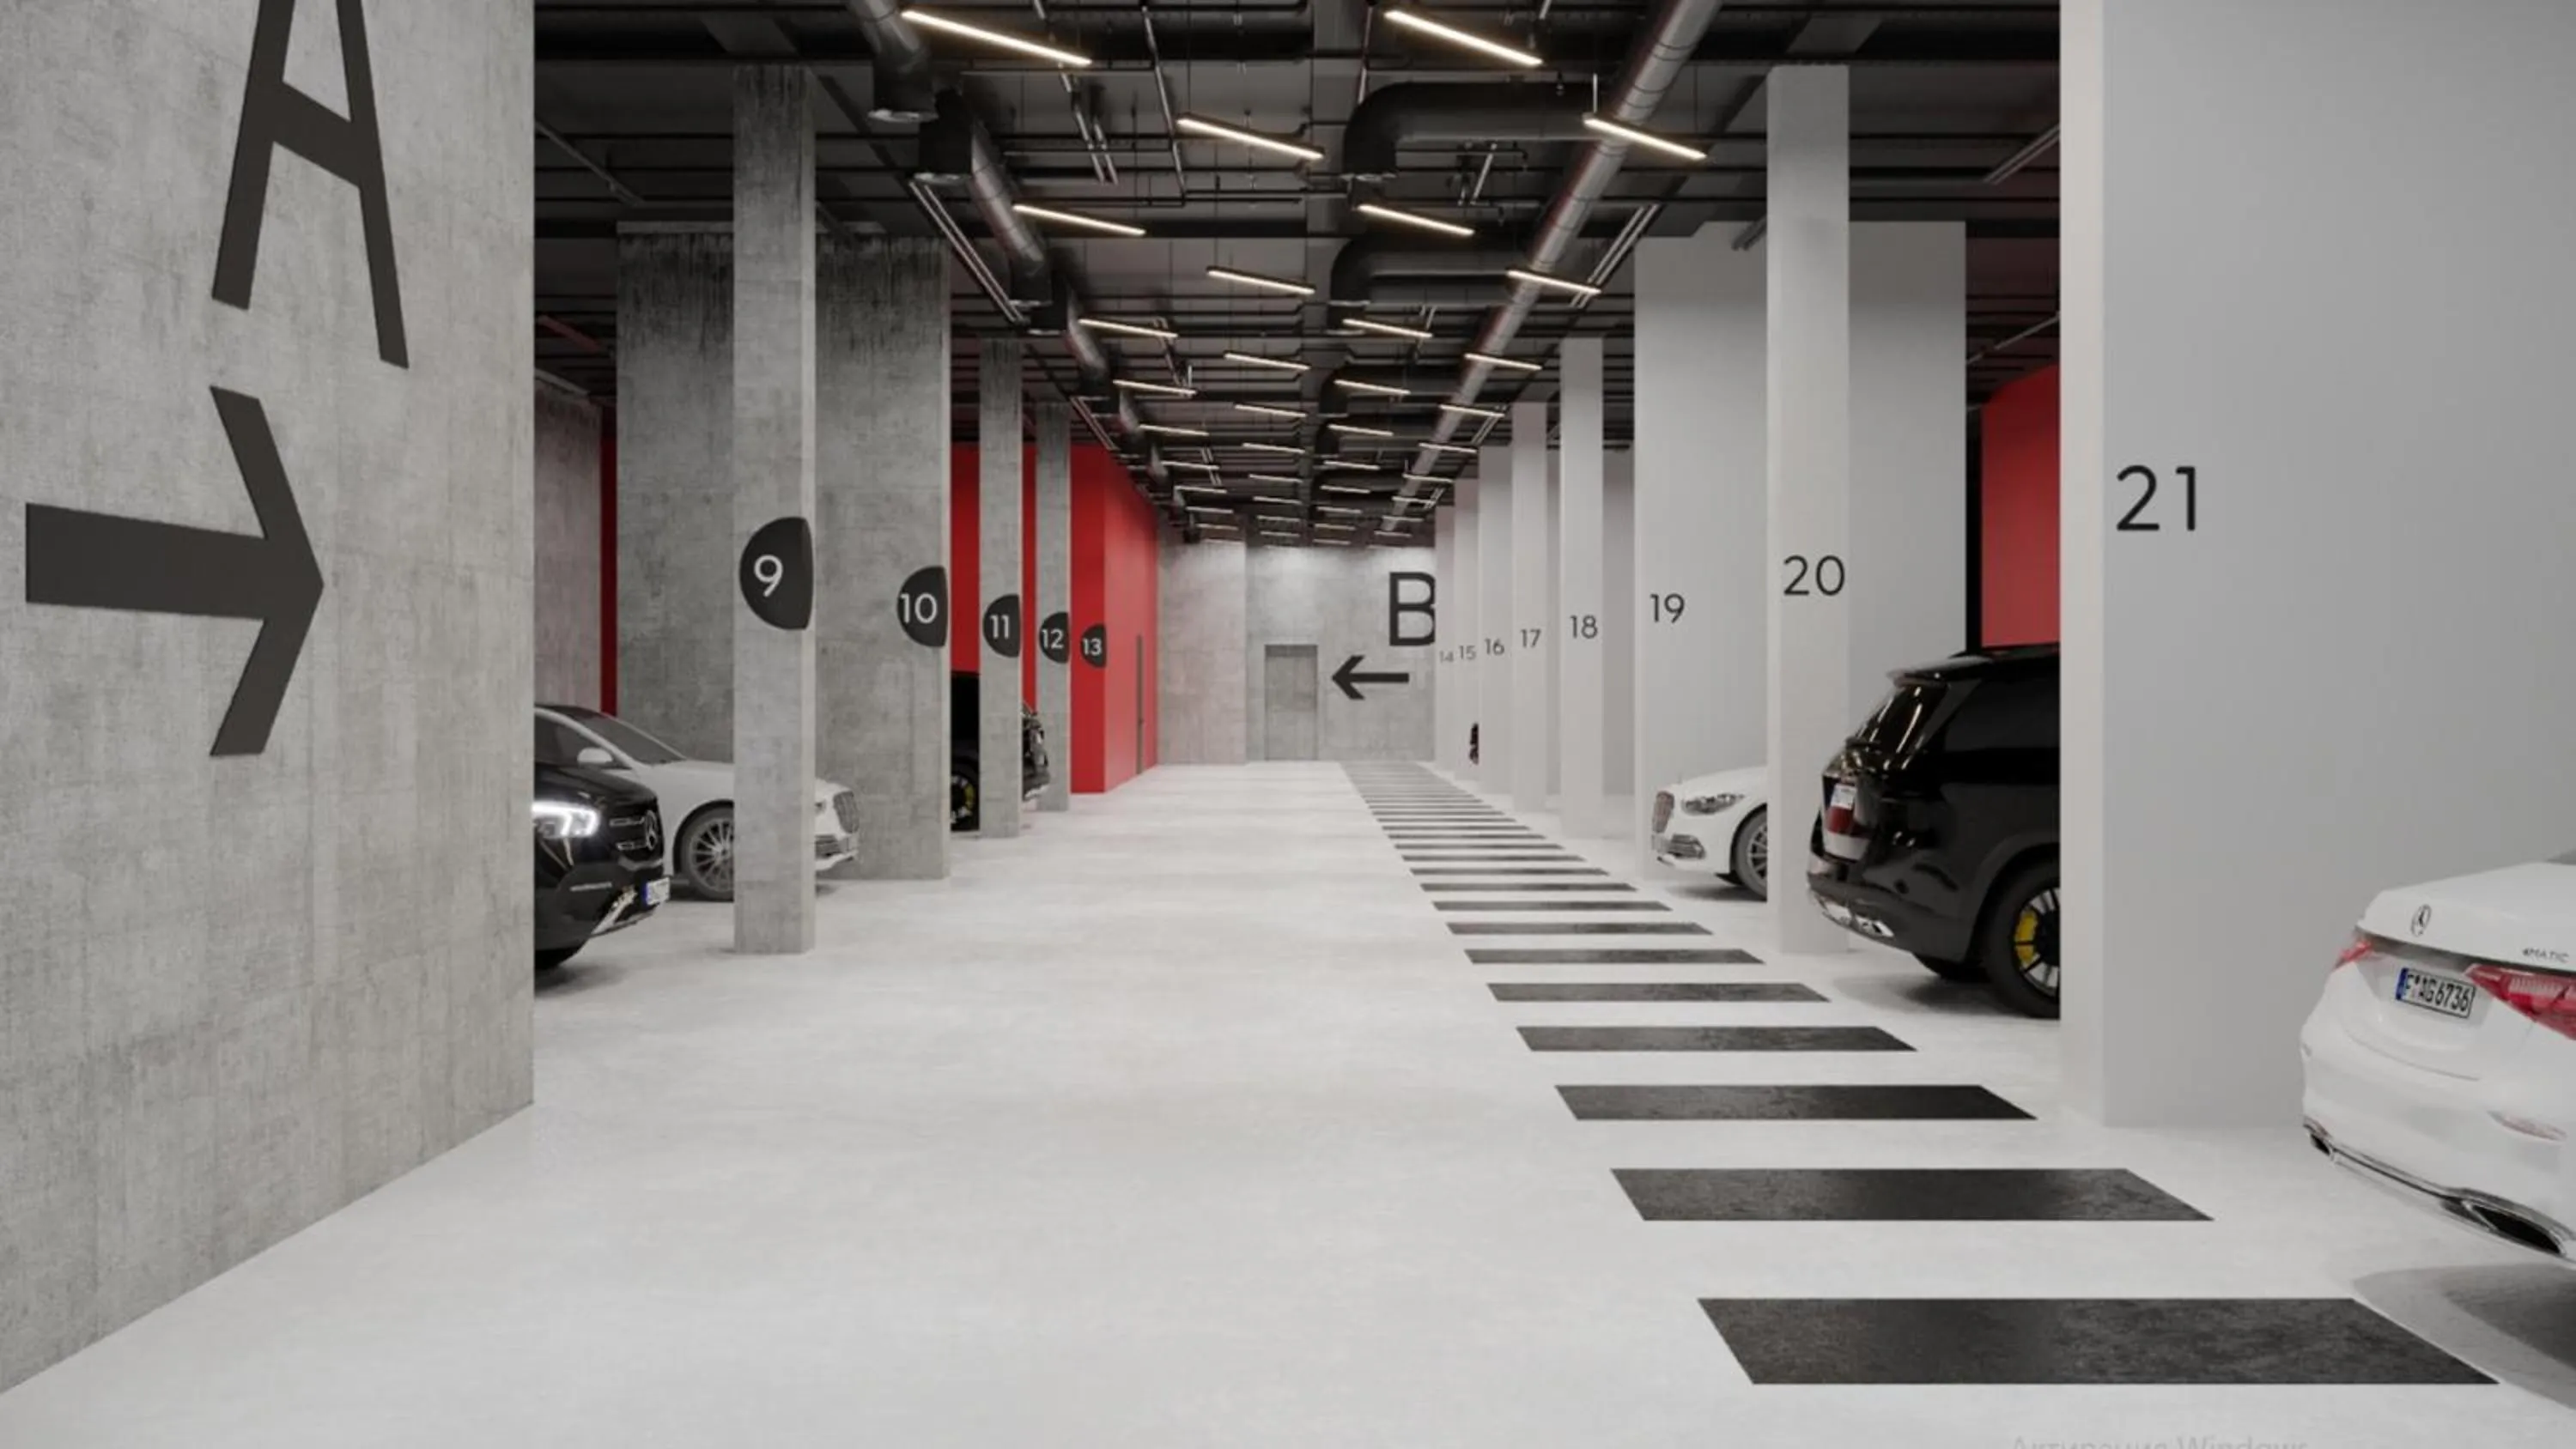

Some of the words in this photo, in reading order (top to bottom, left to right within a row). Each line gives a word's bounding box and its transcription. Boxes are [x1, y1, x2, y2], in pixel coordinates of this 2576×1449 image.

[212, 0, 409, 369] A
[2117, 464, 2196, 531] 21
[754, 555, 783, 597] 9
[1783, 555, 1845, 596] 20
[900, 593, 938, 624] 10
[1388, 572, 1435, 646] B
[1650, 593, 1685, 623] 19
[990, 615, 1009, 640] 11
[1042, 628, 1065, 650] 12
[1520, 628, 1541, 647] 17
[1570, 615, 1598, 639] 18
[1083, 638, 1103, 655] 13
[1439, 651, 1454, 663] 14
[1459, 646, 1476, 660] 15
[1485, 639, 1505, 655] 16
